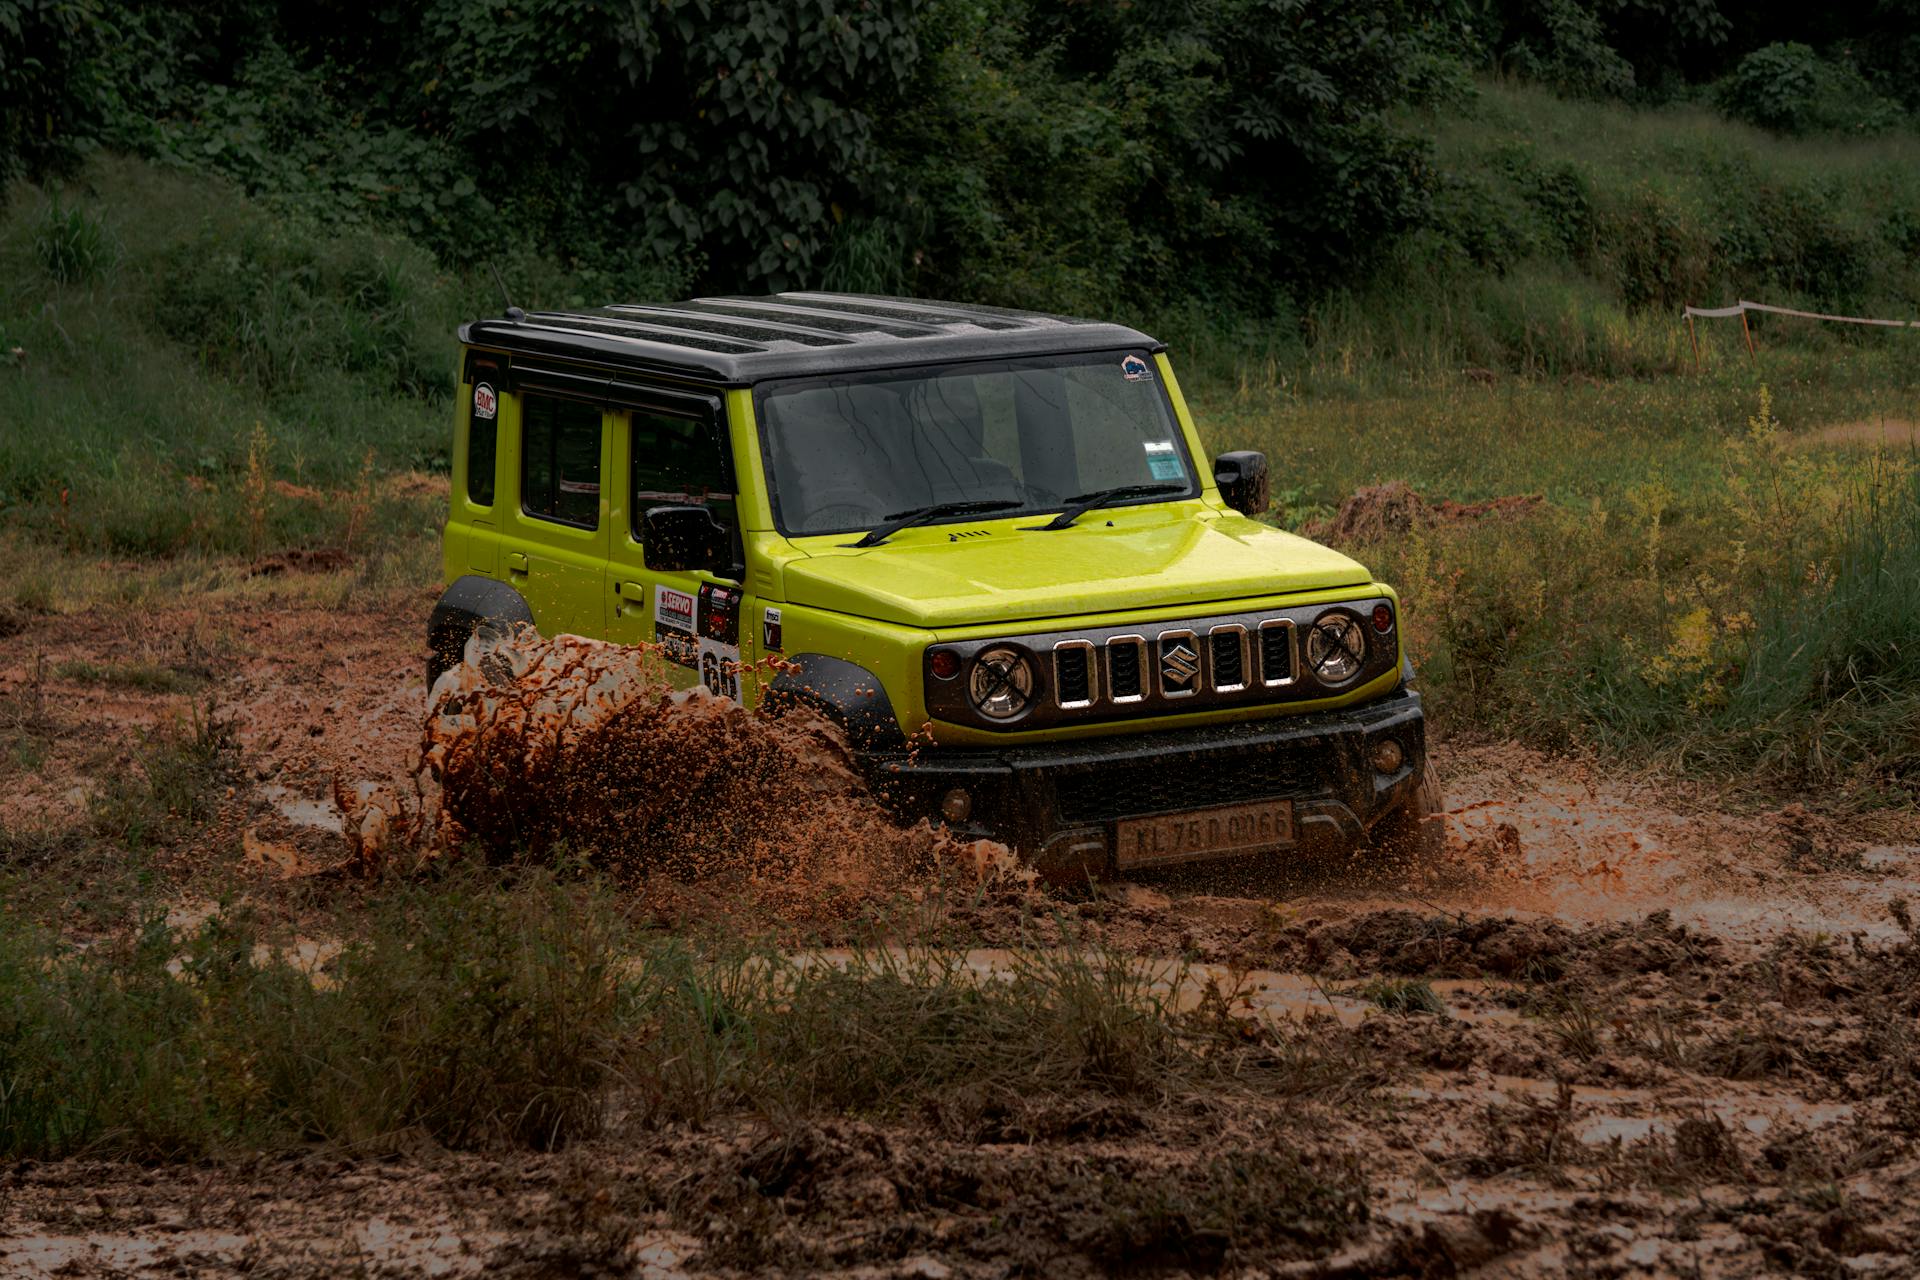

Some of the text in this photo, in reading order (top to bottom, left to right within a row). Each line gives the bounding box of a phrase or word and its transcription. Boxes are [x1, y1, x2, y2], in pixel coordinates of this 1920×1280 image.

[477, 390, 494, 412] BMC
[667, 592, 690, 614] SERVO
[1173, 820, 1201, 850] 75
